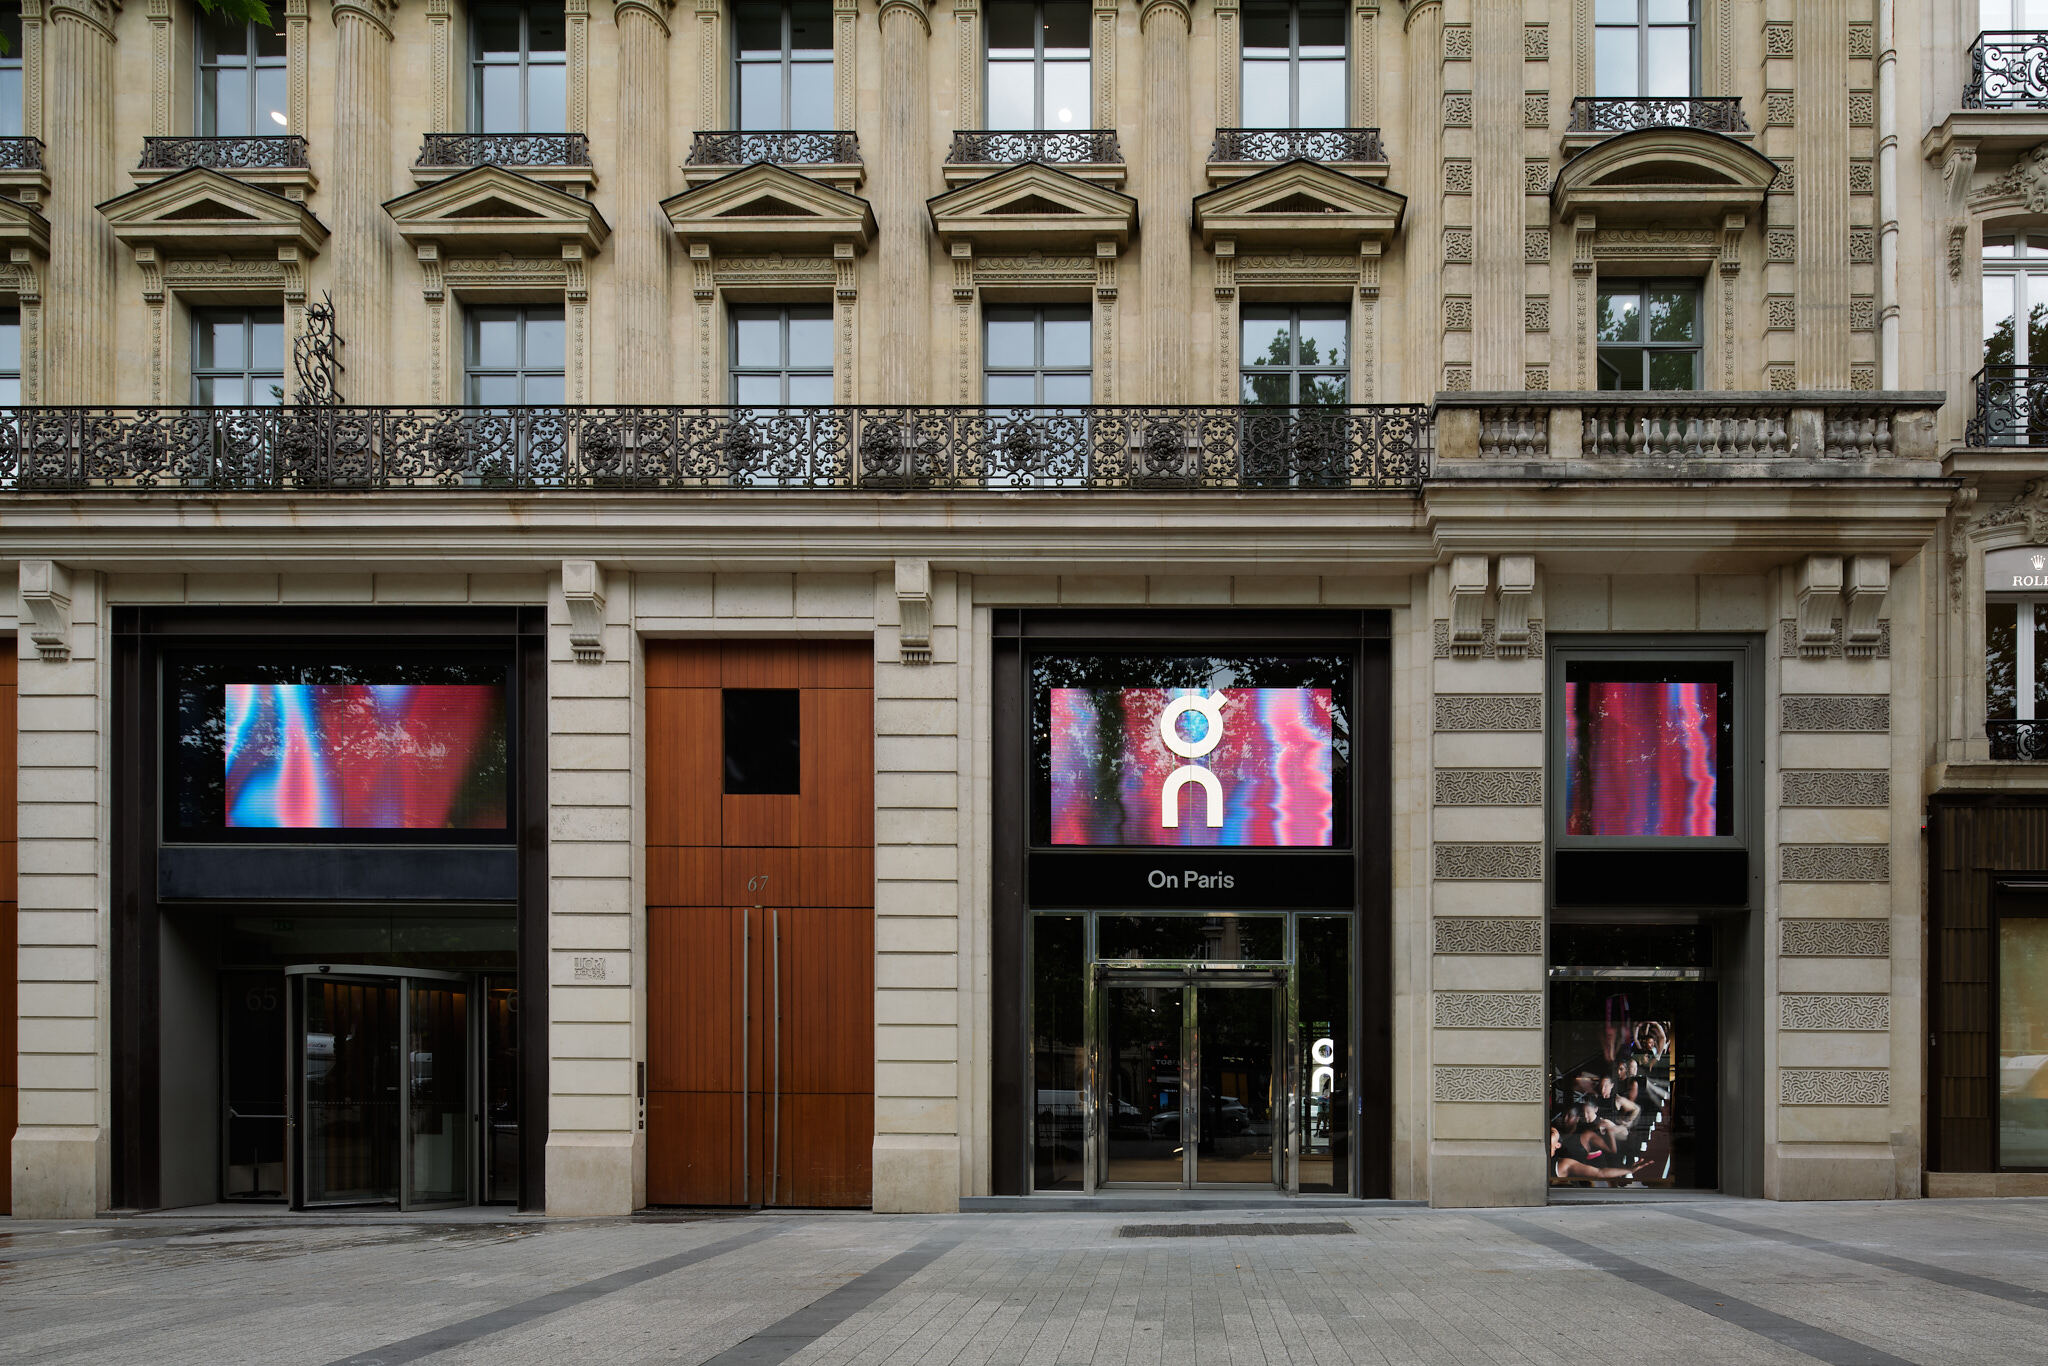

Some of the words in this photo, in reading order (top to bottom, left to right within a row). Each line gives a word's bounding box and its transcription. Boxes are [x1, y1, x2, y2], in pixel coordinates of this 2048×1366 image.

[748, 875, 769, 892] 67
[1148, 869, 1178, 888] On
[1184, 870, 1235, 888] Paris
[246, 986, 277, 1011] 65
